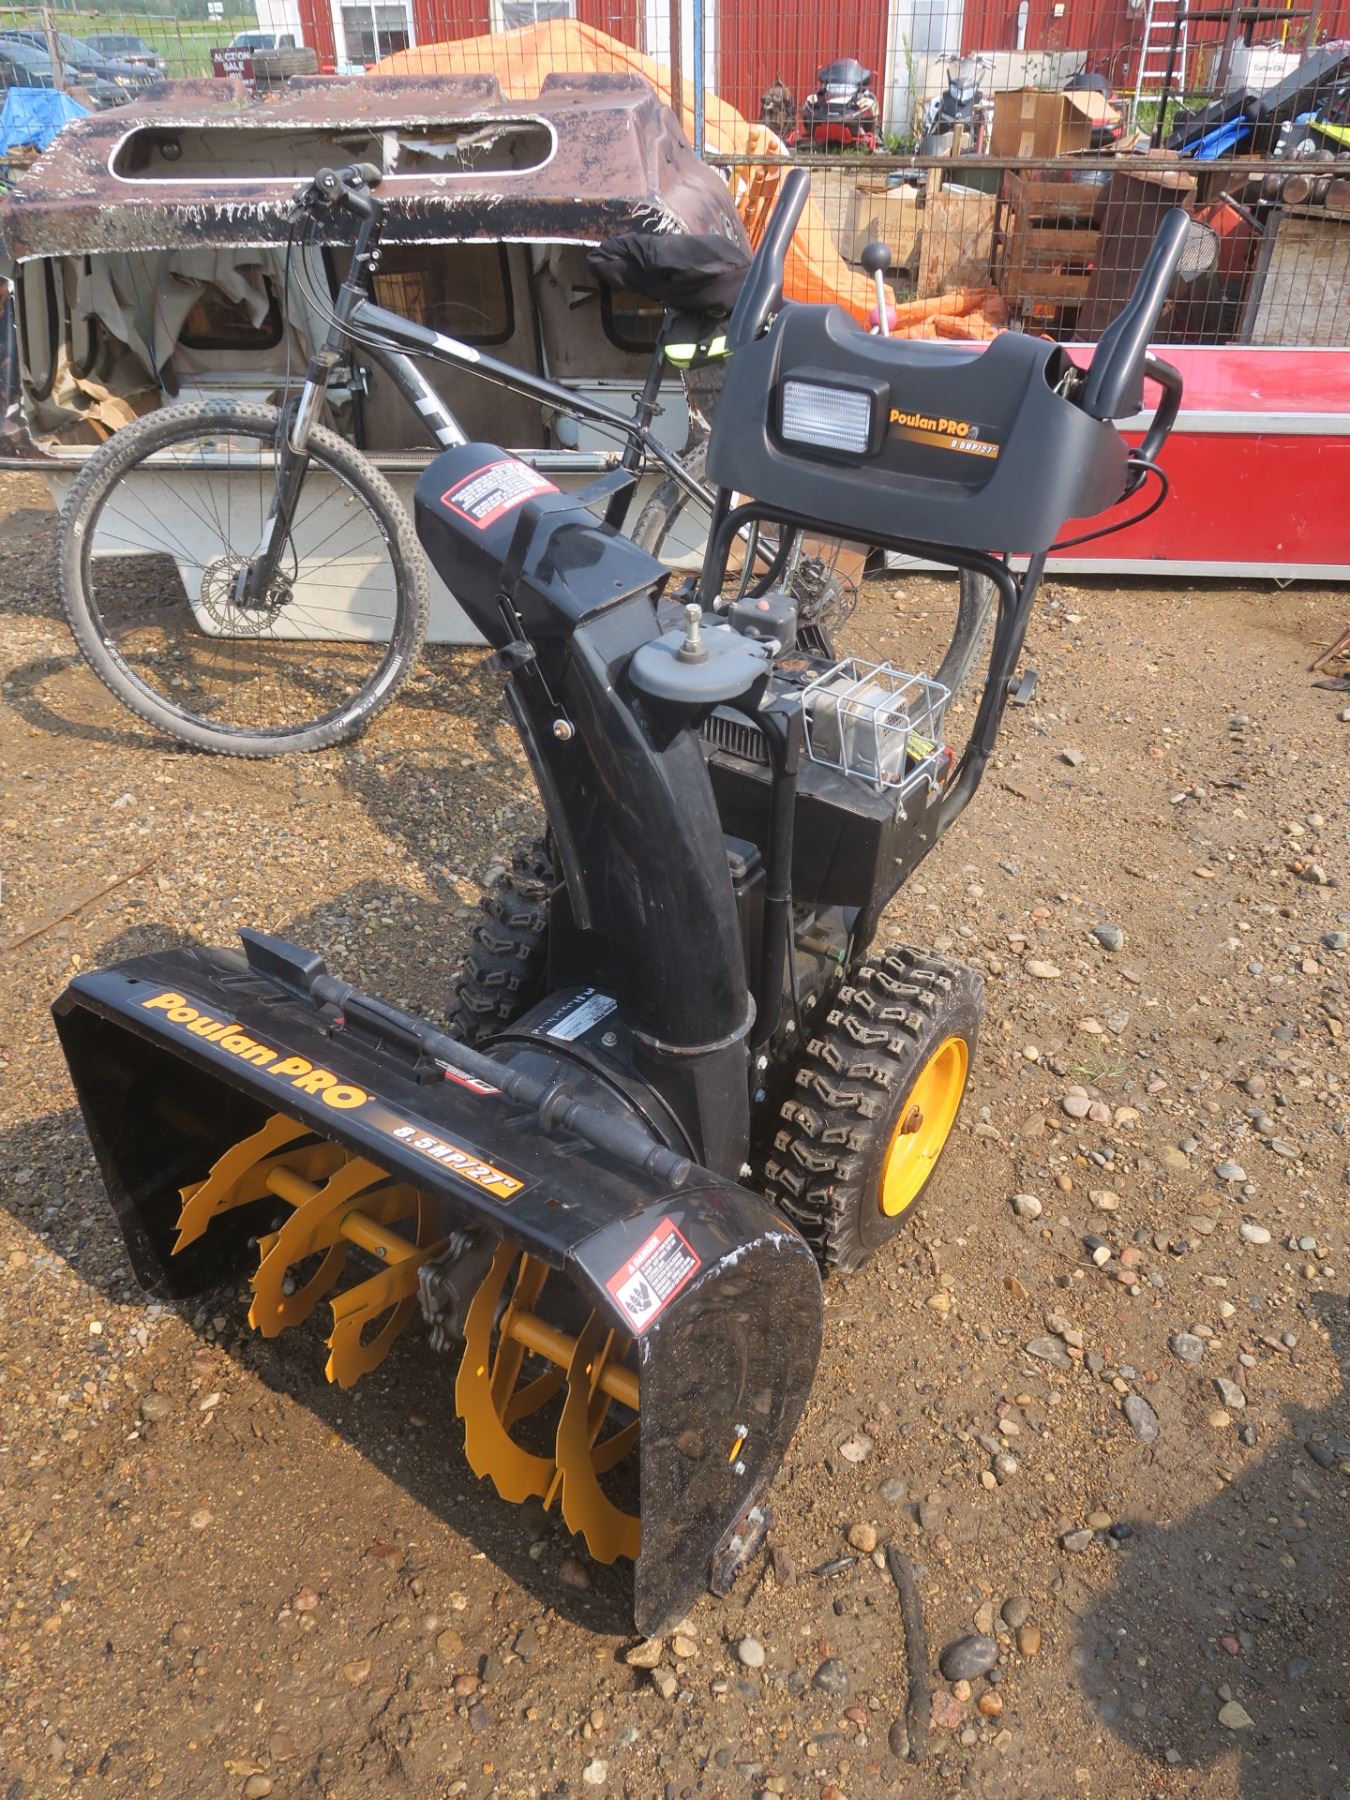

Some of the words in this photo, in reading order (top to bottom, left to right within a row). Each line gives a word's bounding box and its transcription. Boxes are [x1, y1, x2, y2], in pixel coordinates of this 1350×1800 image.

[214, 51, 249, 63] AUCTON
[889, 408, 937, 431] Poulan
[937, 418, 969, 437] PRO
[141, 992, 279, 1067] Poulan
[266, 1056, 367, 1109] PRO
[392, 1126, 517, 1188] 8.5HP/27"
